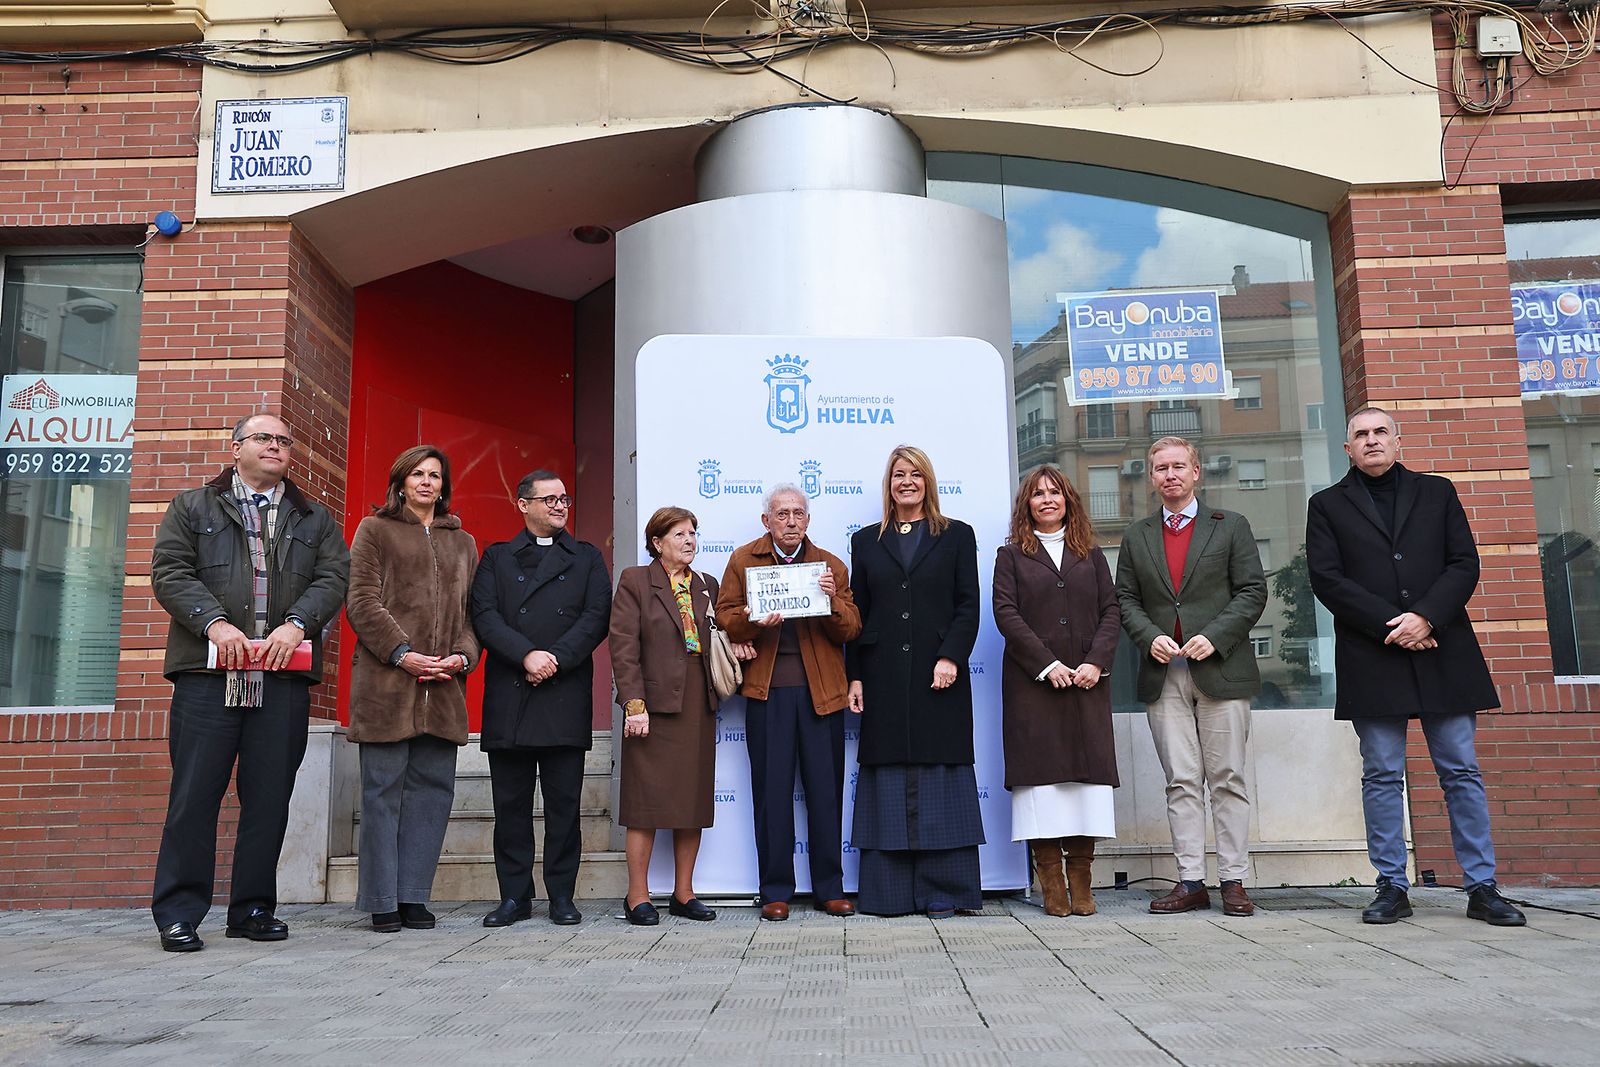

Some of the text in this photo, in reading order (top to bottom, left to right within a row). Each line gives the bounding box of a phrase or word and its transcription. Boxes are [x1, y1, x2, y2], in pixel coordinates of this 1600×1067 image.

[232, 109, 271, 124] RINCÓN
[230, 128, 283, 153] JUAN
[229, 155, 312, 181] ROMERO
[1151, 325, 1214, 338] inmobiliaria
[1105, 341, 1189, 362] VENDE
[1079, 362, 1218, 389] 959 87 04 90
[1561, 357, 1589, 379] 87
[1118, 386, 1184, 395] www.bayonuba.com
[32, 396, 134, 409] EU INMOBILIAR
[817, 394, 895, 405] Ayuntamiento de
[817, 407, 895, 424] HUELVA
[6, 453, 44, 474] 959
[51, 453, 91, 473] 822
[724, 485, 763, 494] HUELVA
[824, 486, 863, 494] HUELVA
[938, 486, 962, 494] ELVA
[757, 582, 789, 598] JUAN
[758, 596, 811, 614] ROMERO
[725, 733, 746, 742] HUE
